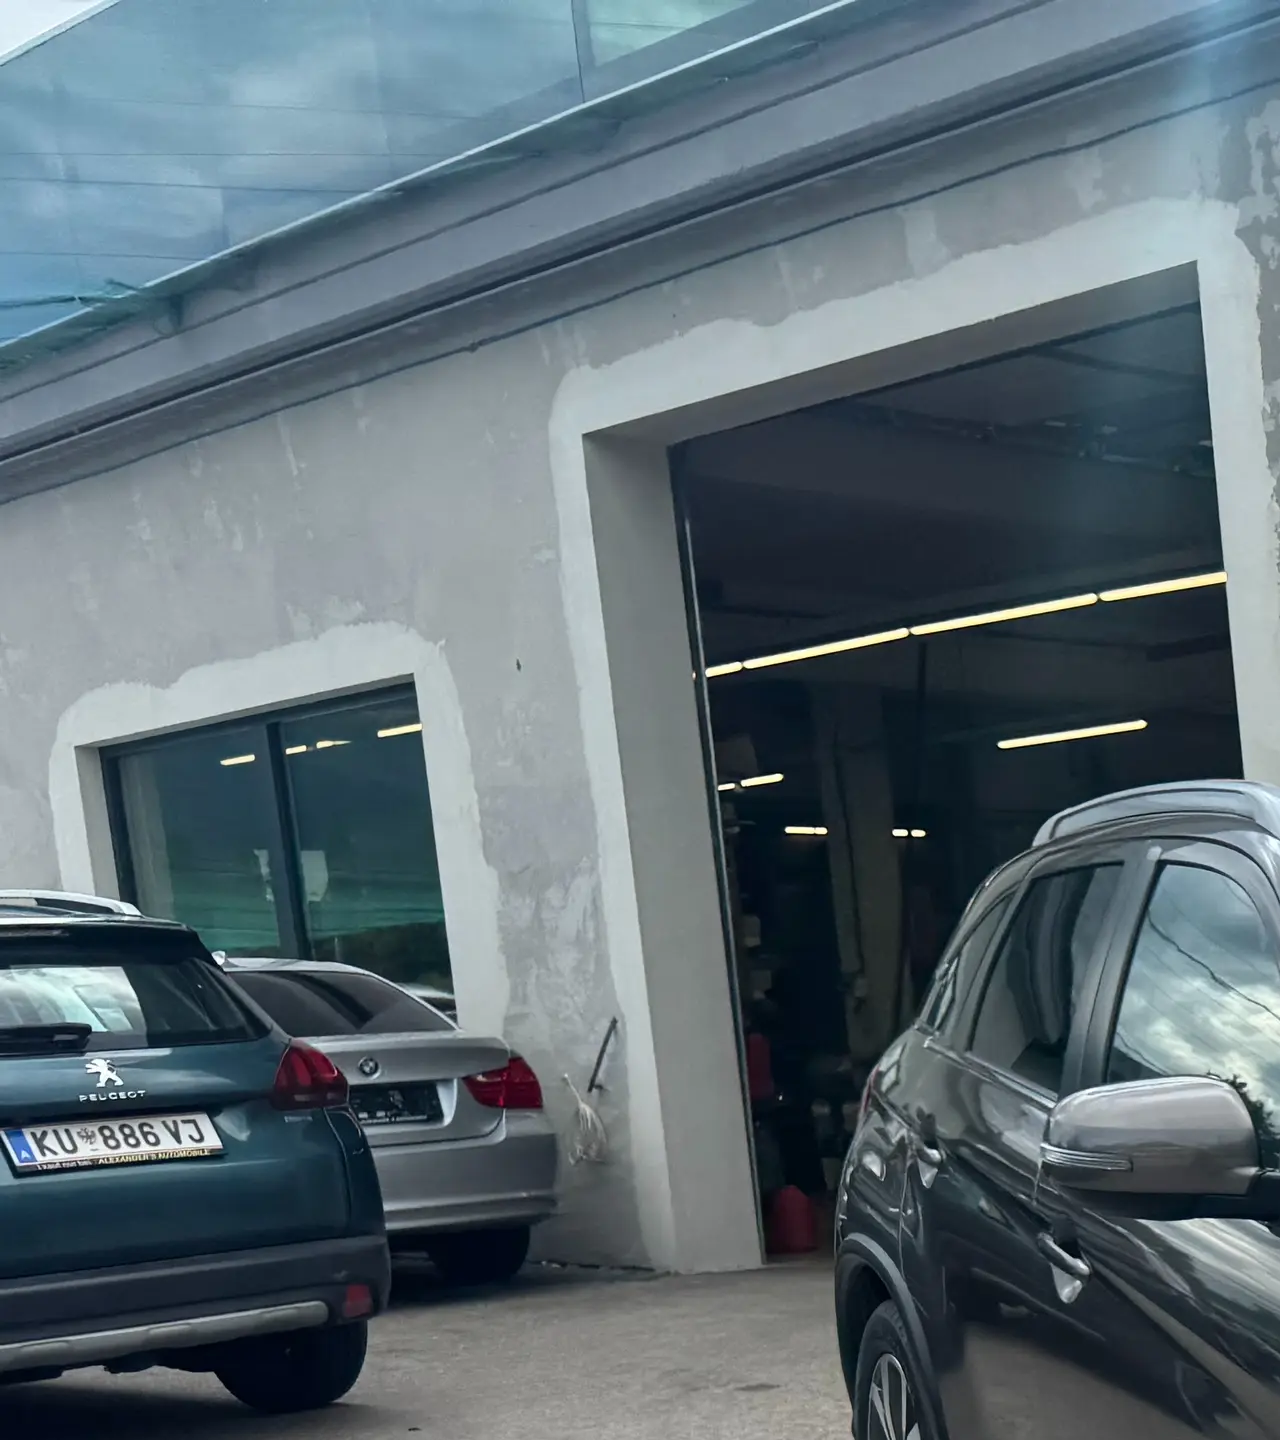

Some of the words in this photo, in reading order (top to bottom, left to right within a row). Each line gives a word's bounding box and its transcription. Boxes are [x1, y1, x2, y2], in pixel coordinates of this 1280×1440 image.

[79, 1090, 147, 1103] PEUGEOT
[30, 1127, 79, 1158] KU
[97, 1121, 162, 1151] 886
[161, 1118, 206, 1144] VJ
